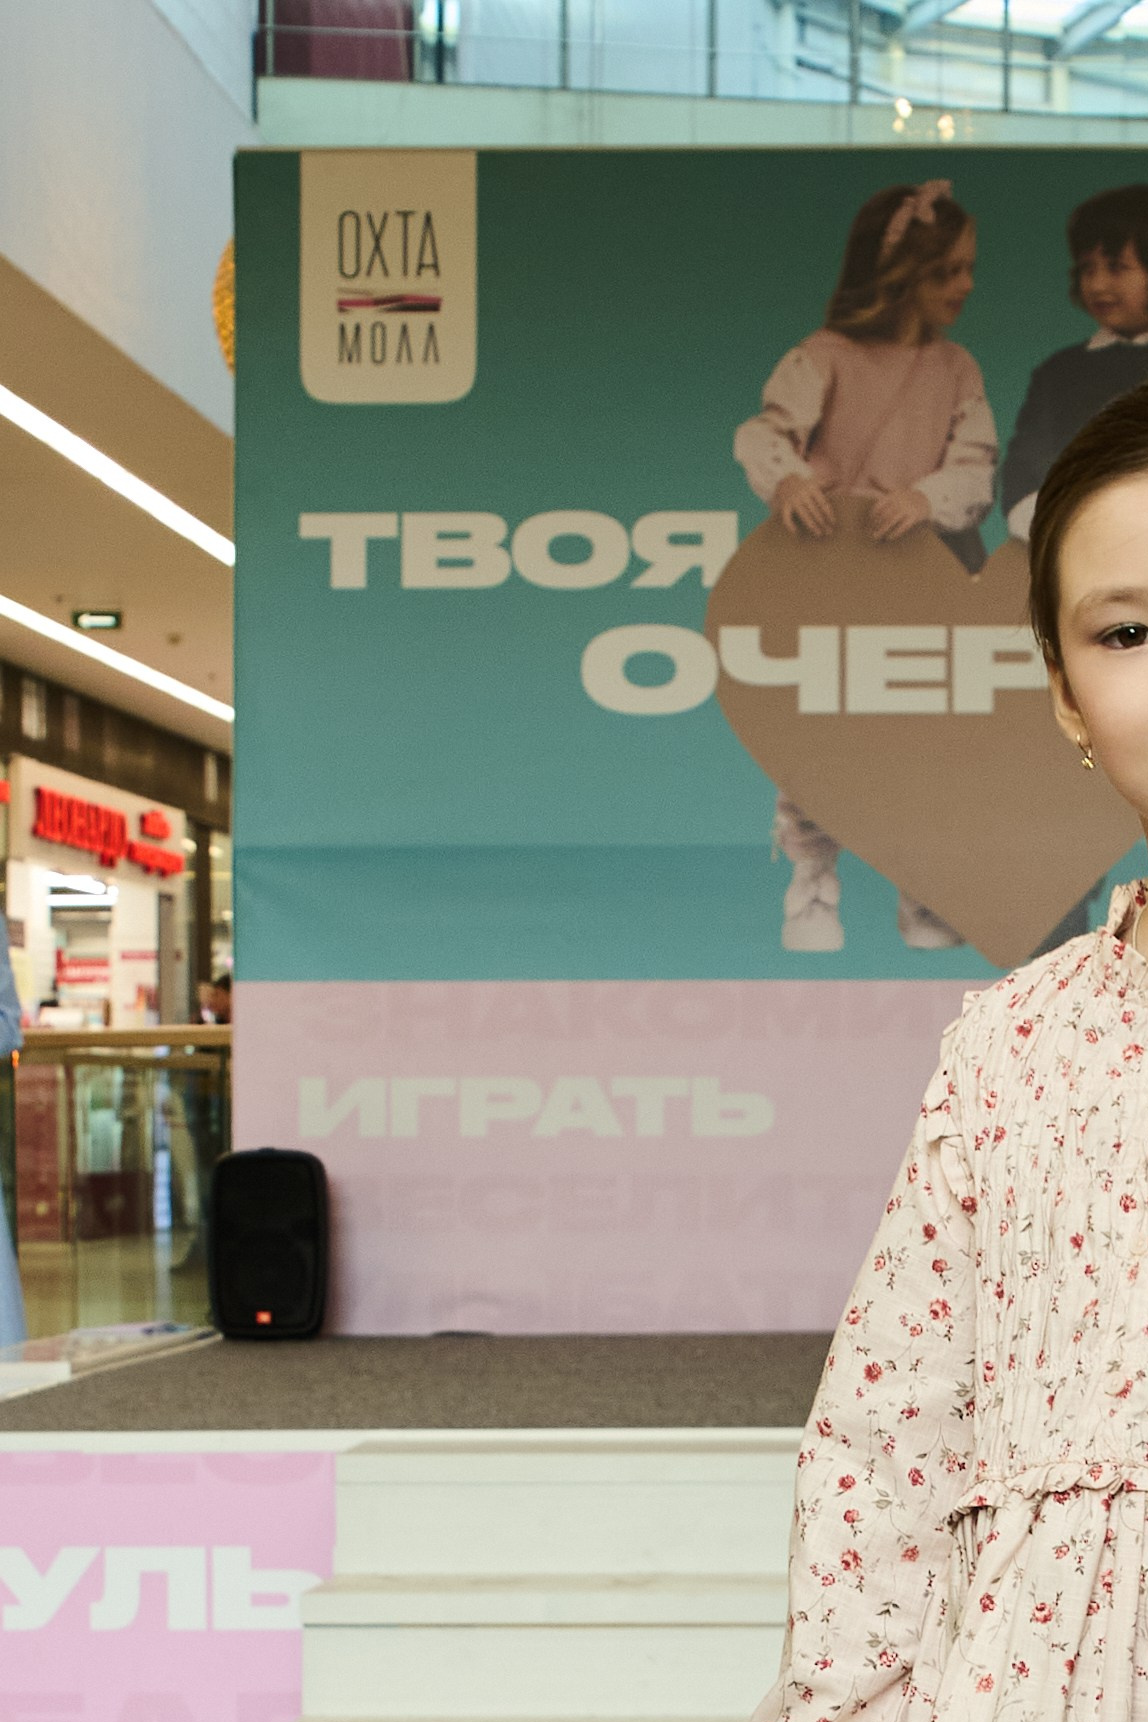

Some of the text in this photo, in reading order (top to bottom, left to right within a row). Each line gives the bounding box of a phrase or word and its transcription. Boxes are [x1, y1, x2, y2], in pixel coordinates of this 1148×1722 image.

[337, 211, 440, 278] ОХТА
[338, 322, 440, 365] МОЛЛ
[300, 511, 738, 590] ТВОЯ
[301, 1077, 776, 1138] ИГРАТЬ
